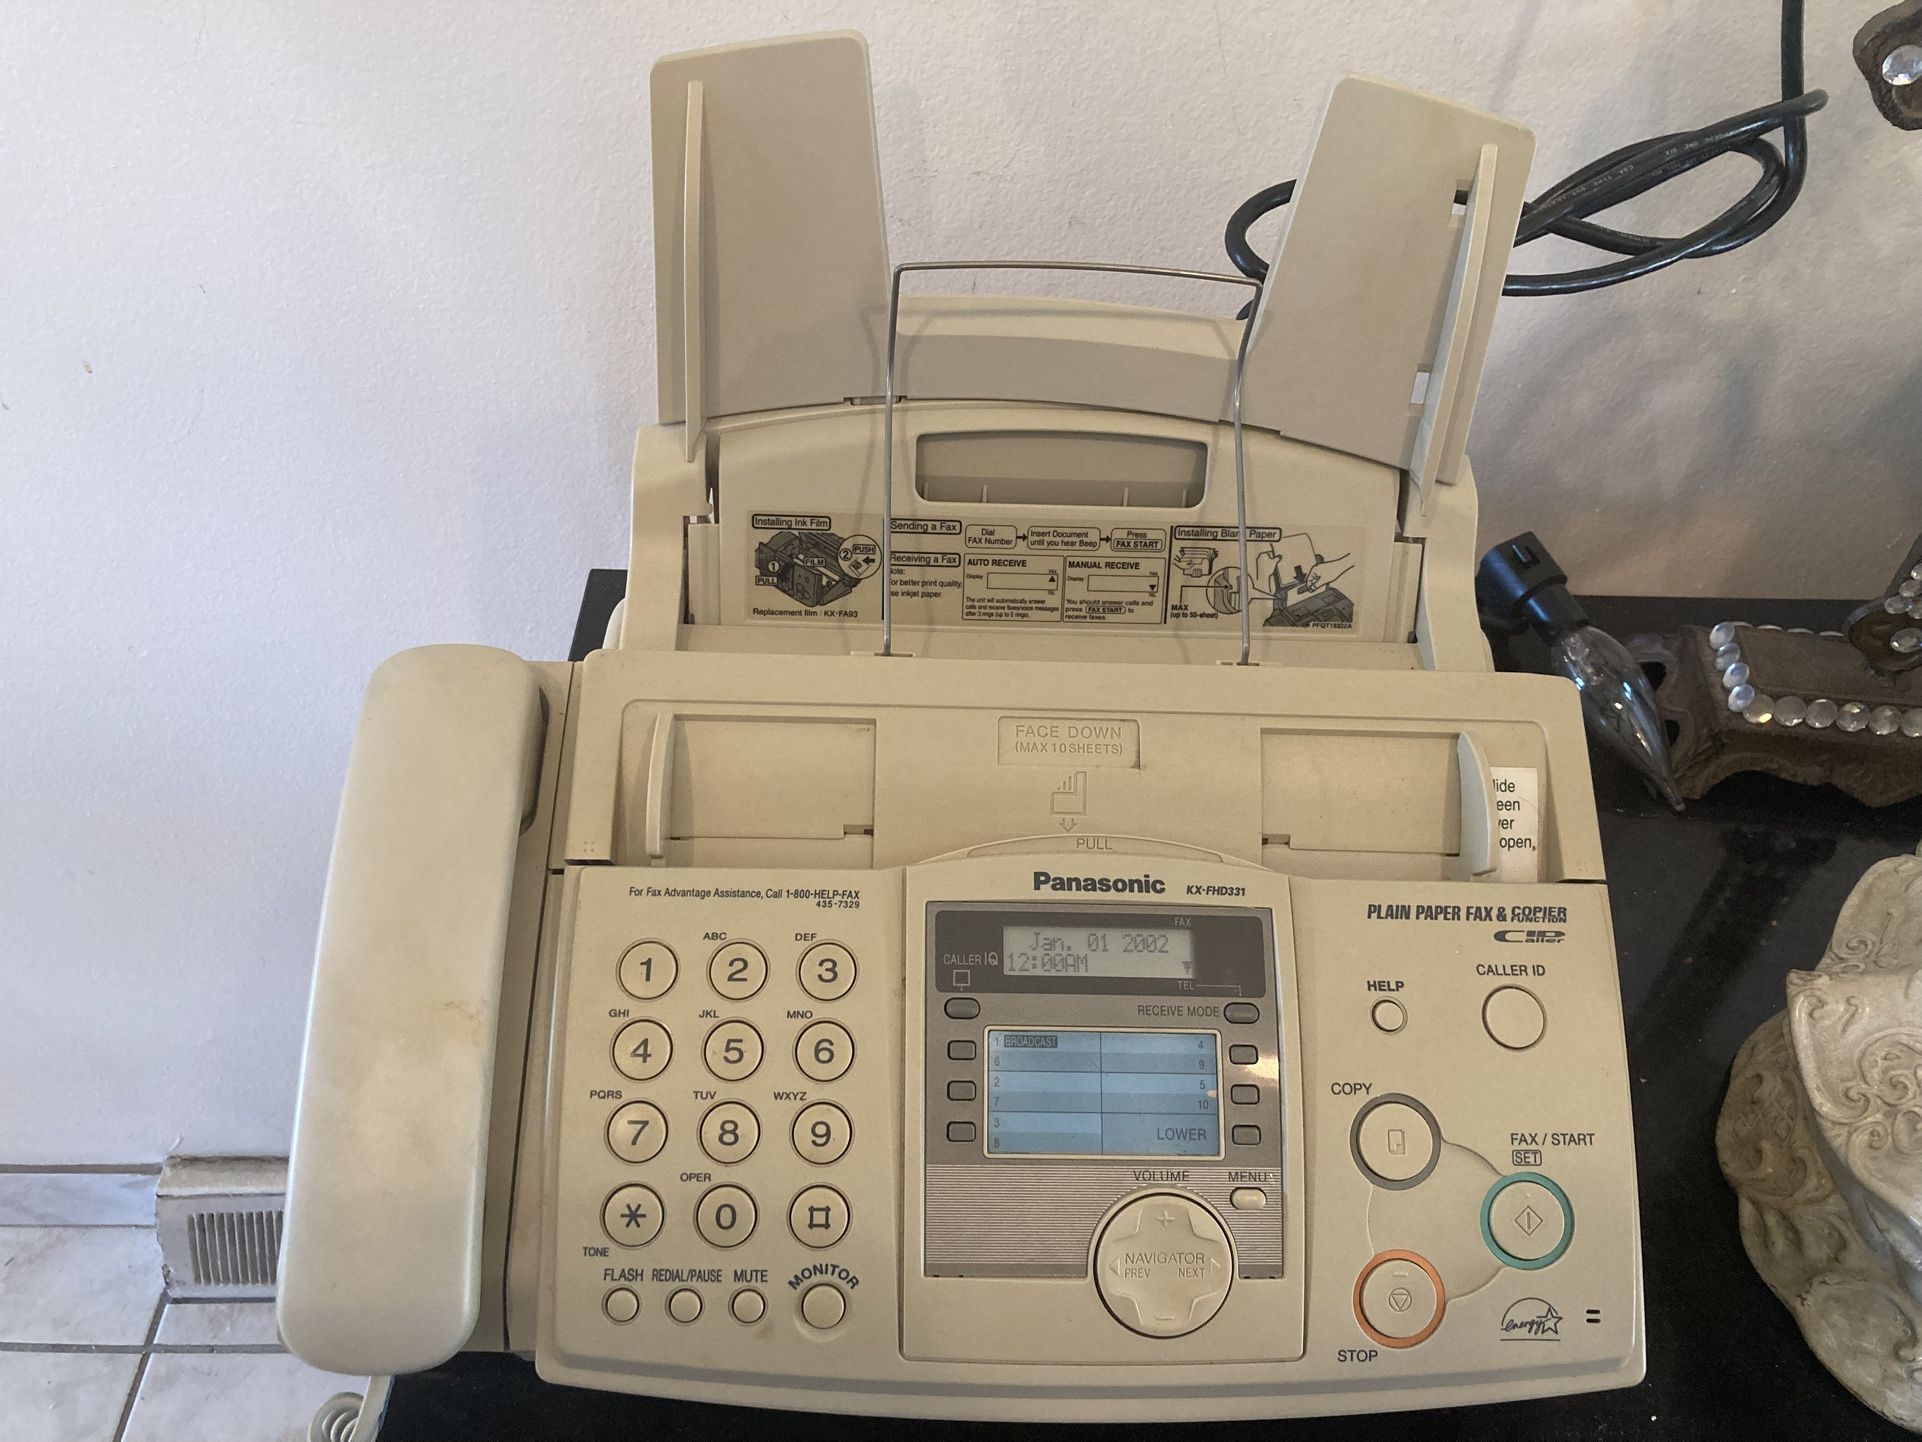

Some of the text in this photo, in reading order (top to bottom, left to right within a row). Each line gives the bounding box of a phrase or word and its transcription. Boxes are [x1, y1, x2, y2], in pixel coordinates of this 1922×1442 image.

[755, 517, 828, 529] Installing Ink Film
[891, 521, 928, 532] Sending
[940, 523, 957, 531] Fax
[981, 528, 995, 536] Dial
[1177, 528, 1218, 539] Installing
[1250, 530, 1277, 540] Paper
[984, 538, 1012, 546] Number
[1079, 540, 1097, 548] Beep
[1133, 541, 1159, 549] START
[854, 545, 875, 554] PUSH
[804, 558, 825, 566] FILM
[891, 554, 931, 565] Receiving
[942, 555, 957, 564] Fax
[967, 559, 1027, 568] AUTO RECEIVE
[1068, 561, 1140, 570] MANUAL RECEIVE
[757, 577, 776, 585] PULL
[922, 580, 937, 588] print
[752, 608, 858, 618] Replacement film KX-FA93
[1016, 725, 1122, 739] FACE DOWN
[1077, 838, 1112, 850] PULL
[1033, 871, 1166, 894] Panasonic
[629, 887, 860, 900] For Fax Advantage Assistance, Call 1-800-HELP-FAX
[1185, 885, 1246, 897] KX-FHD331
[815, 900, 860, 909] 435-7329
[1367, 904, 1567, 922] PLAIN PAPER FAX & COPIER
[1174, 917, 1192, 927] FAX
[703, 932, 727, 941] ABC
[794, 933, 817, 942] DEF
[1030, 932, 1169, 953] Jan. 01 2002
[943, 954, 981, 965] CALLER
[1008, 952, 1088, 973] 12:00AM
[640, 957, 652, 982] 1
[727, 957, 749, 982] 2
[817, 958, 838, 983] 3
[1476, 964, 1545, 976] CALLER ID
[1177, 981, 1194, 990] TEL
[1367, 981, 1404, 992] HELP
[608, 1009, 629, 1018] GHI
[699, 1010, 720, 1019] JKL
[786, 1010, 813, 1019] MNO
[1138, 1005, 1219, 1017] RECEIVE MODE
[1004, 1036, 1057, 1047] BROADCAST
[1198, 1039, 1204, 1049] 4
[630, 1038, 652, 1063] 4
[723, 1038, 744, 1064] 5
[814, 1038, 834, 1064] 6
[994, 1077, 1000, 1088] 2
[1199, 1080, 1205, 1090] 5
[589, 1090, 623, 1099] PQRS
[1331, 1083, 1372, 1095] COPY
[693, 1090, 717, 1100] TUV
[773, 1091, 807, 1101] WXYZ
[994, 1097, 999, 1107] 7
[1198, 1099, 1209, 1110] 10
[994, 1117, 1000, 1128] 3
[627, 1120, 650, 1146] 7
[718, 1120, 739, 1146] 8
[811, 1120, 832, 1147] 9
[1157, 1128, 1207, 1141] LOWER
[1511, 1133, 1538, 1145] FAX
[1551, 1133, 1595, 1146] START
[1515, 1152, 1539, 1164] SET
[680, 1172, 712, 1183] OPER
[1133, 1170, 1190, 1182] VOLUME
[1228, 1171, 1267, 1182] MENU
[715, 1203, 737, 1230] 0
[582, 1246, 609, 1257] TONE
[1125, 1252, 1205, 1265] NAVIGATOR
[603, 1268, 644, 1282] FLASH
[651, 1269, 723, 1282] REDIAL/PAUSE
[733, 1269, 768, 1283] MUTE
[788, 1263, 860, 1290] MONITOR
[1125, 1267, 1205, 1278] PREV NEXT
[1503, 1317, 1543, 1335] energy
[1337, 1350, 1378, 1362] STOP
